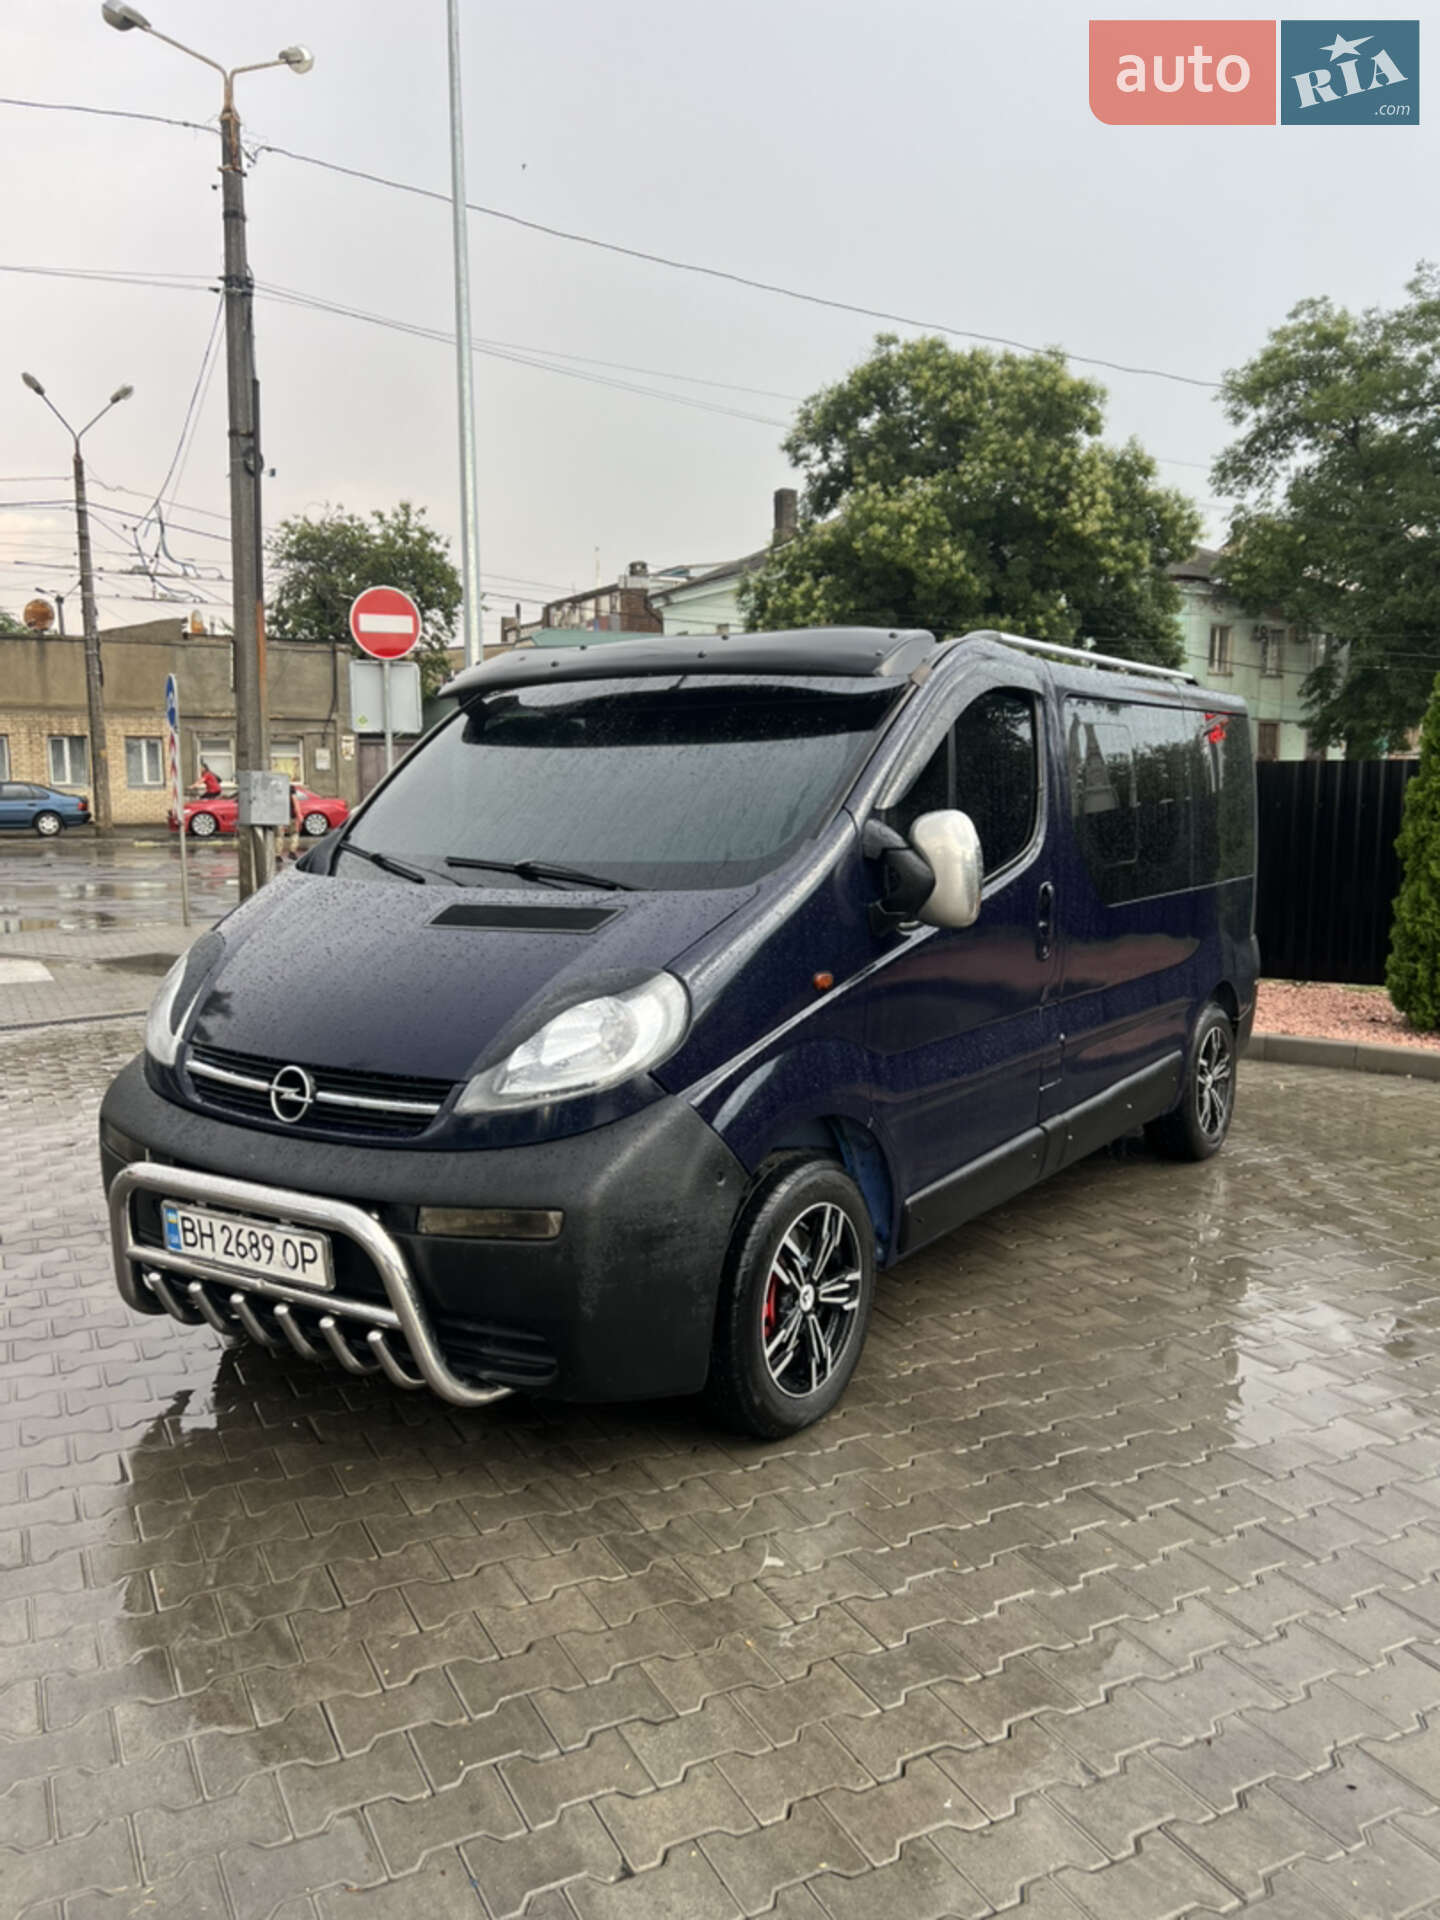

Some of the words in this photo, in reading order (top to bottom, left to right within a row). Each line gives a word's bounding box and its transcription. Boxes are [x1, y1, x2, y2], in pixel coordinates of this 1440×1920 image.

[180, 1216, 216, 1252] BH
[220, 1225, 274, 1265] 2689
[282, 1238, 318, 1274] OP
